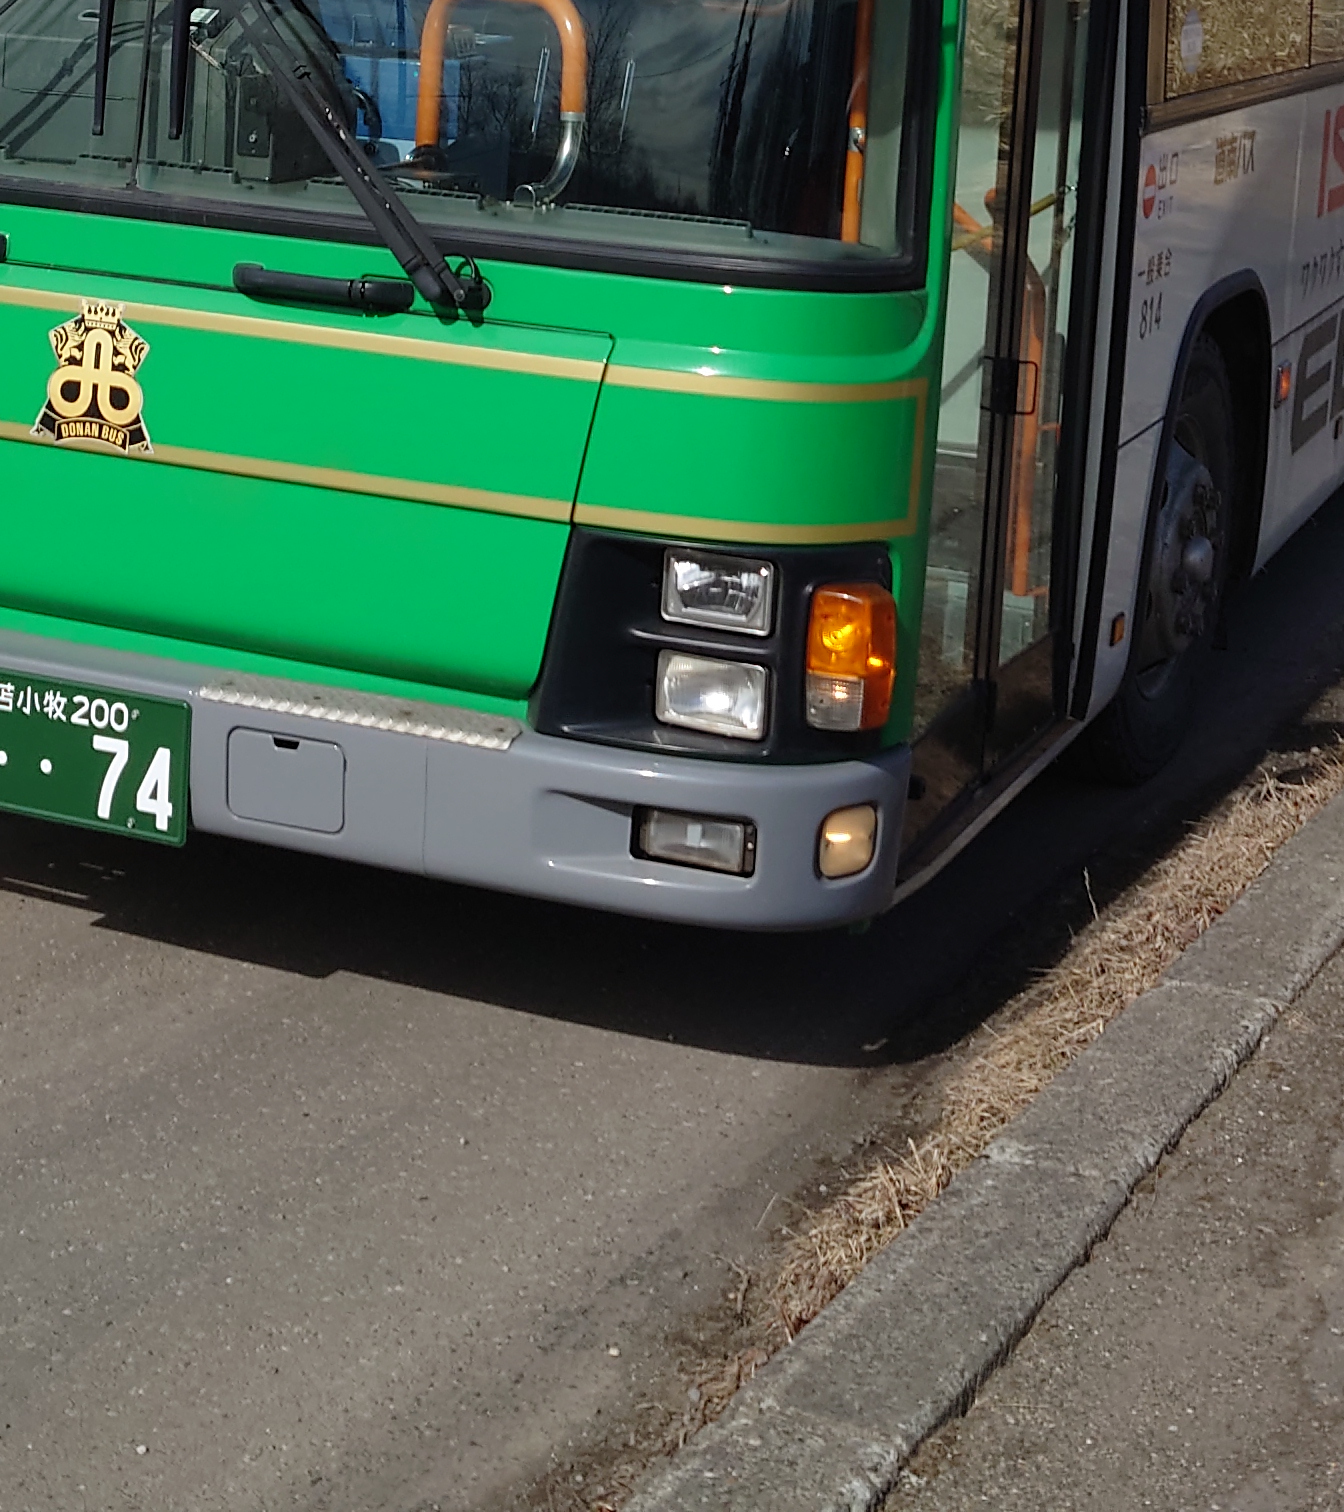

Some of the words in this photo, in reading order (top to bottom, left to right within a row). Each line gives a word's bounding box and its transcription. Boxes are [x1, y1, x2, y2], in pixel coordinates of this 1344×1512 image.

[1139, 291, 1163, 340] 814
[60, 421, 100, 439] DONAN
[101, 424, 125, 446] BUS
